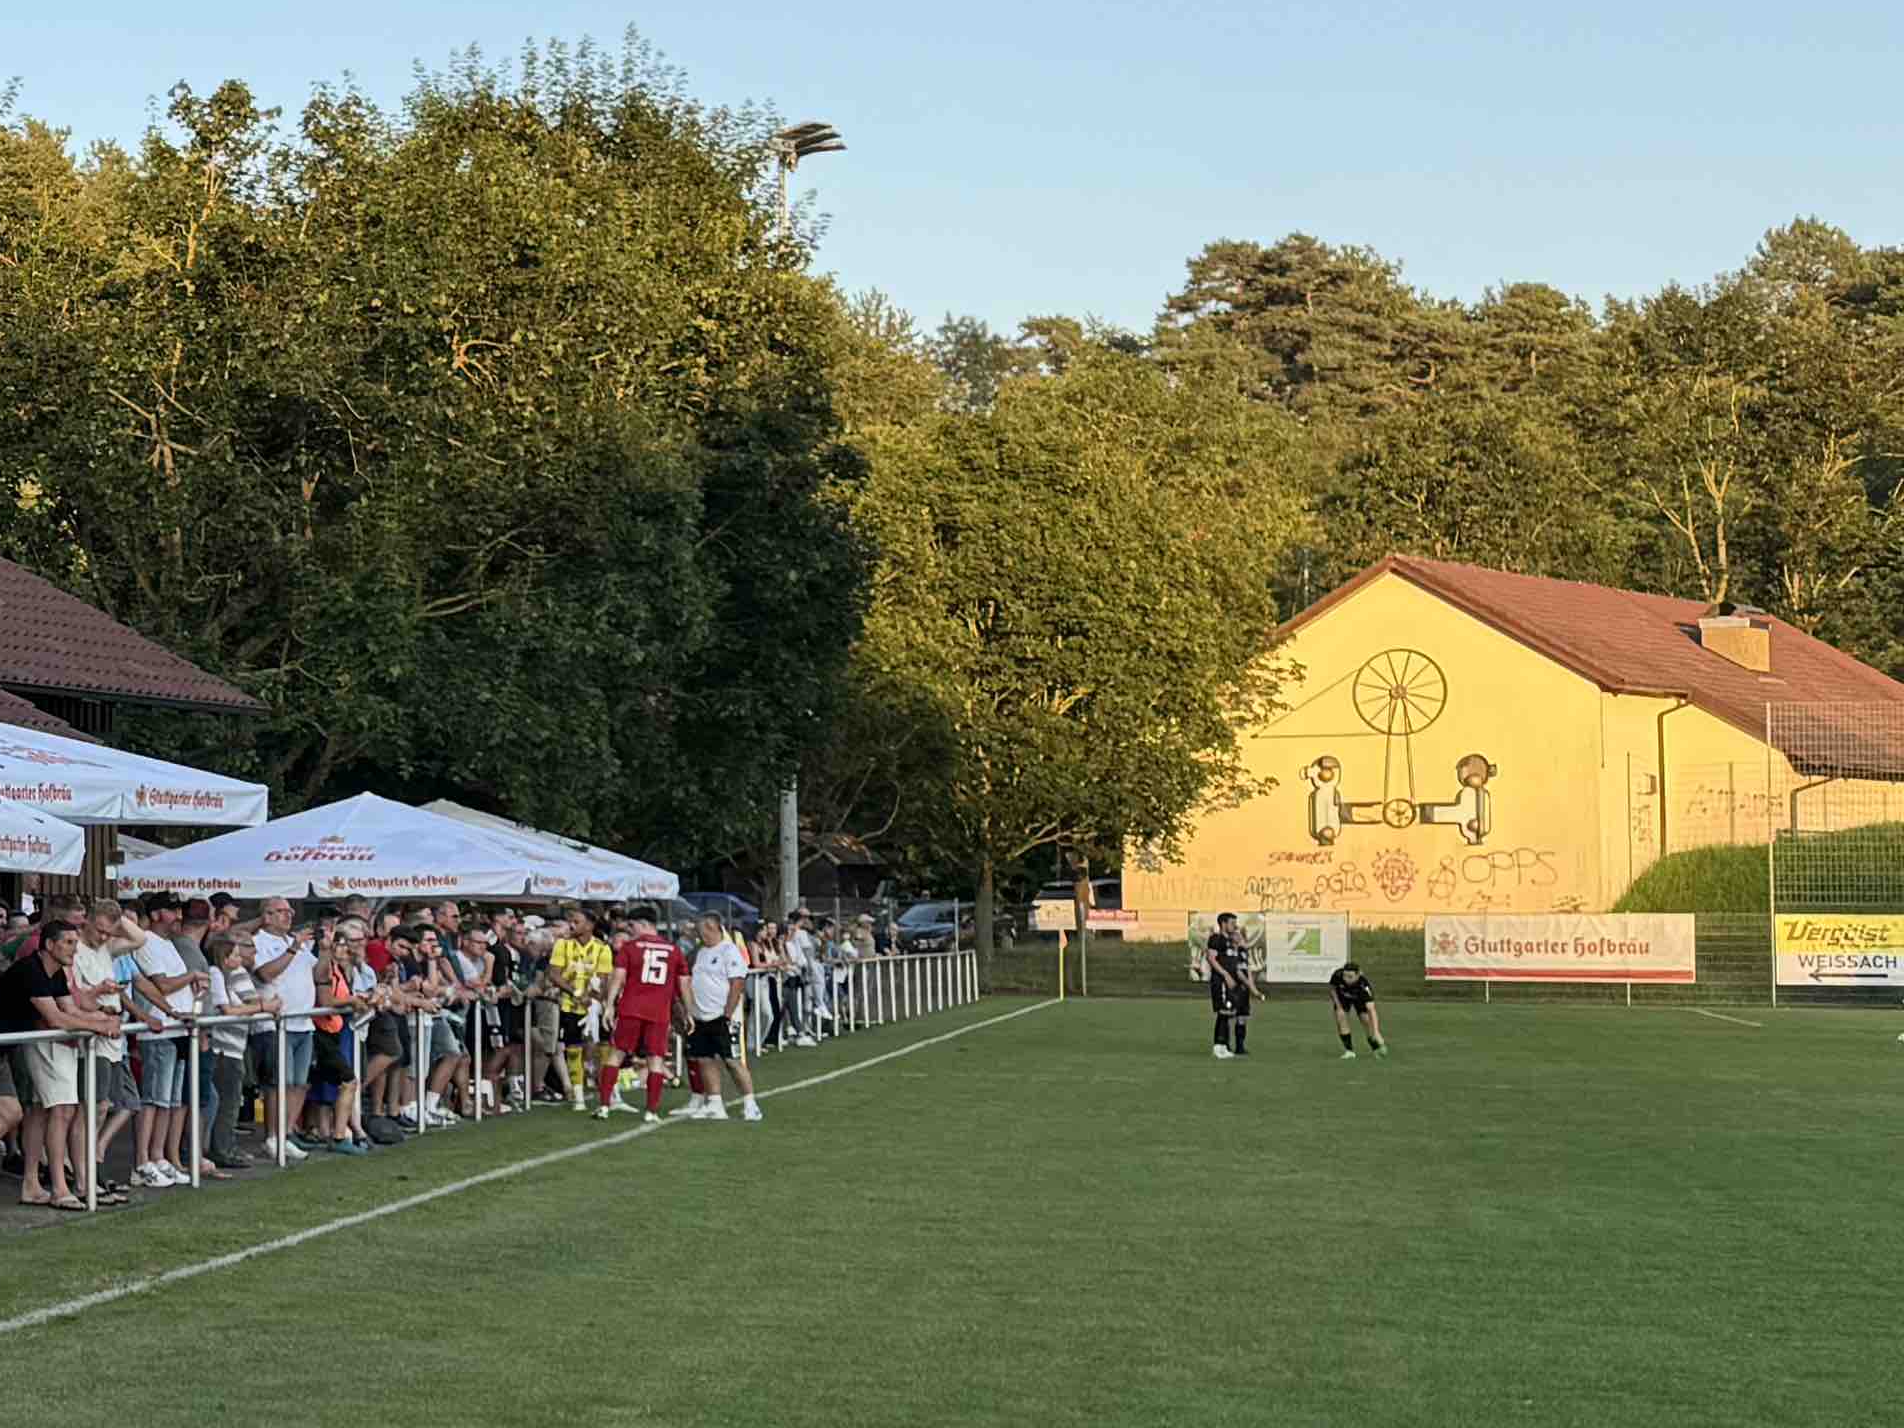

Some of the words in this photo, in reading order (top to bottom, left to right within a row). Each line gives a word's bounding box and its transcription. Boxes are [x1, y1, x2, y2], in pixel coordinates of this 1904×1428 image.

[1461, 847, 1558, 887] OPPS
[1464, 936, 1568, 956] Stuttgarter
[1573, 937, 1650, 956] Hofbräu
[640, 948, 670, 984] 15
[1798, 956, 1897, 969] WEISSACH
